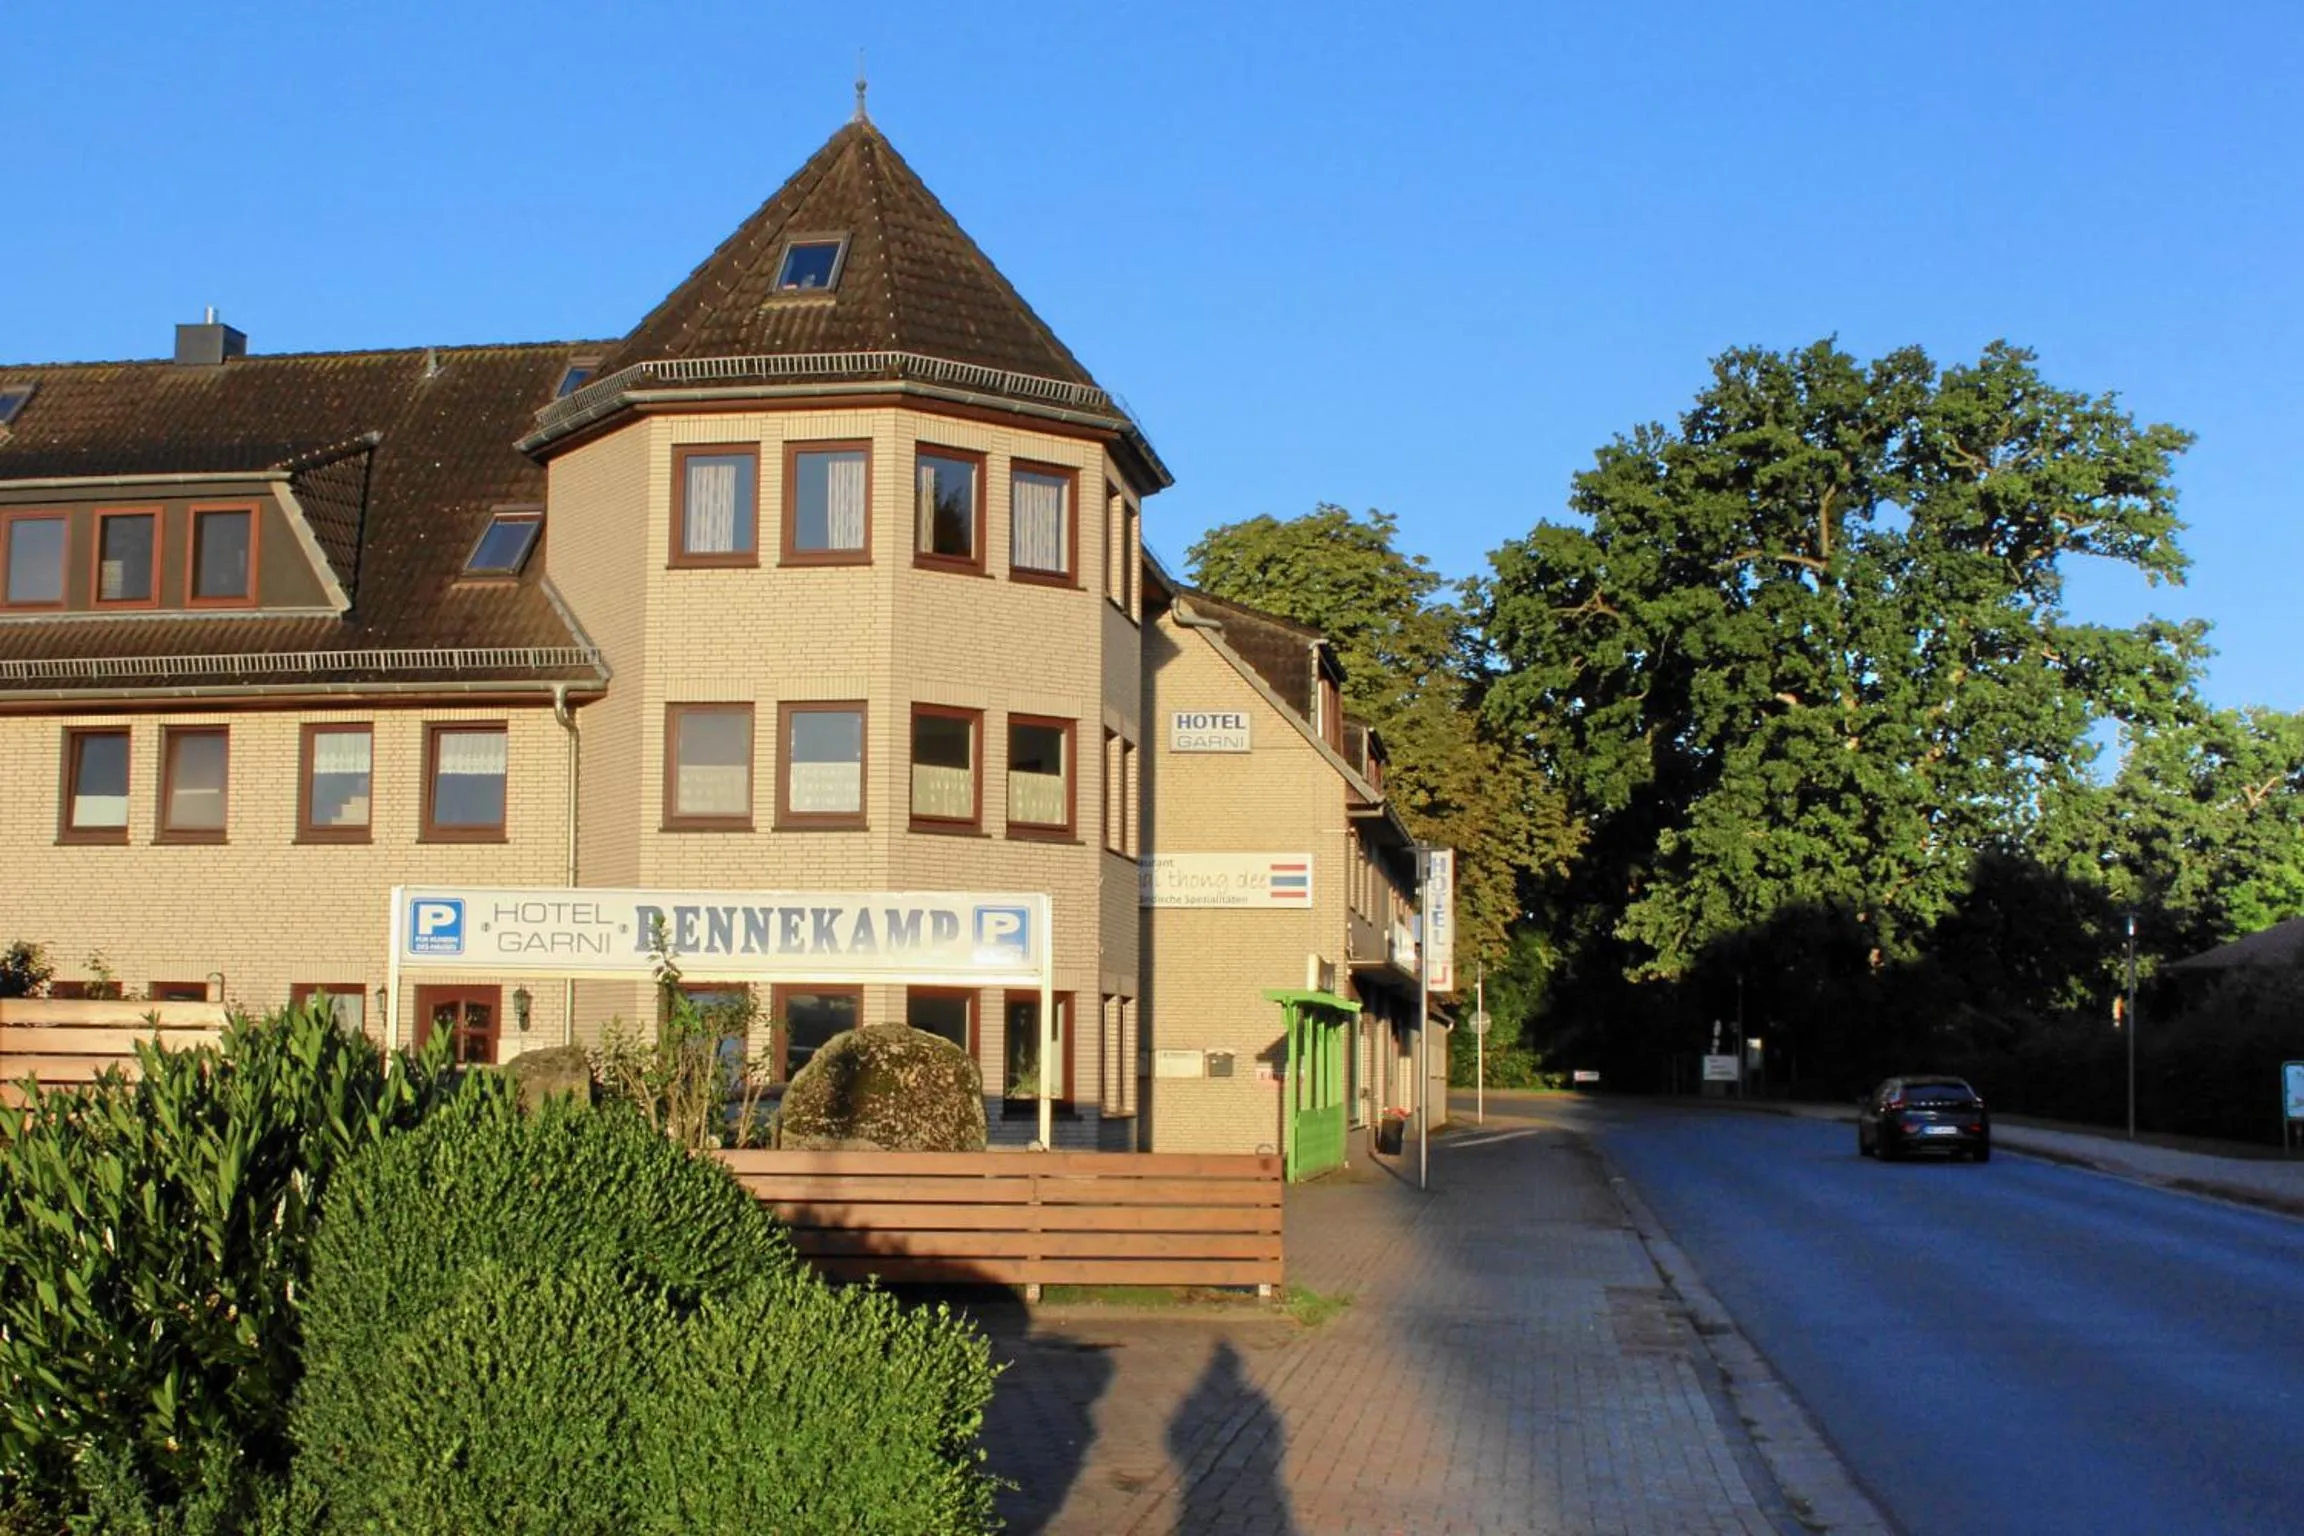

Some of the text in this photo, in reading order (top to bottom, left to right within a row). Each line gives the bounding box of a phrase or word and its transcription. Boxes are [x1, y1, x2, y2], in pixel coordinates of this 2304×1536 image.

[1177, 714, 1246, 729] HOTEL
[1177, 735, 1244, 748] GARNI
[419, 904, 457, 935] P
[493, 902, 614, 925] HOTEL
[982, 911, 1020, 945] P
[497, 931, 611, 954] GARNI
